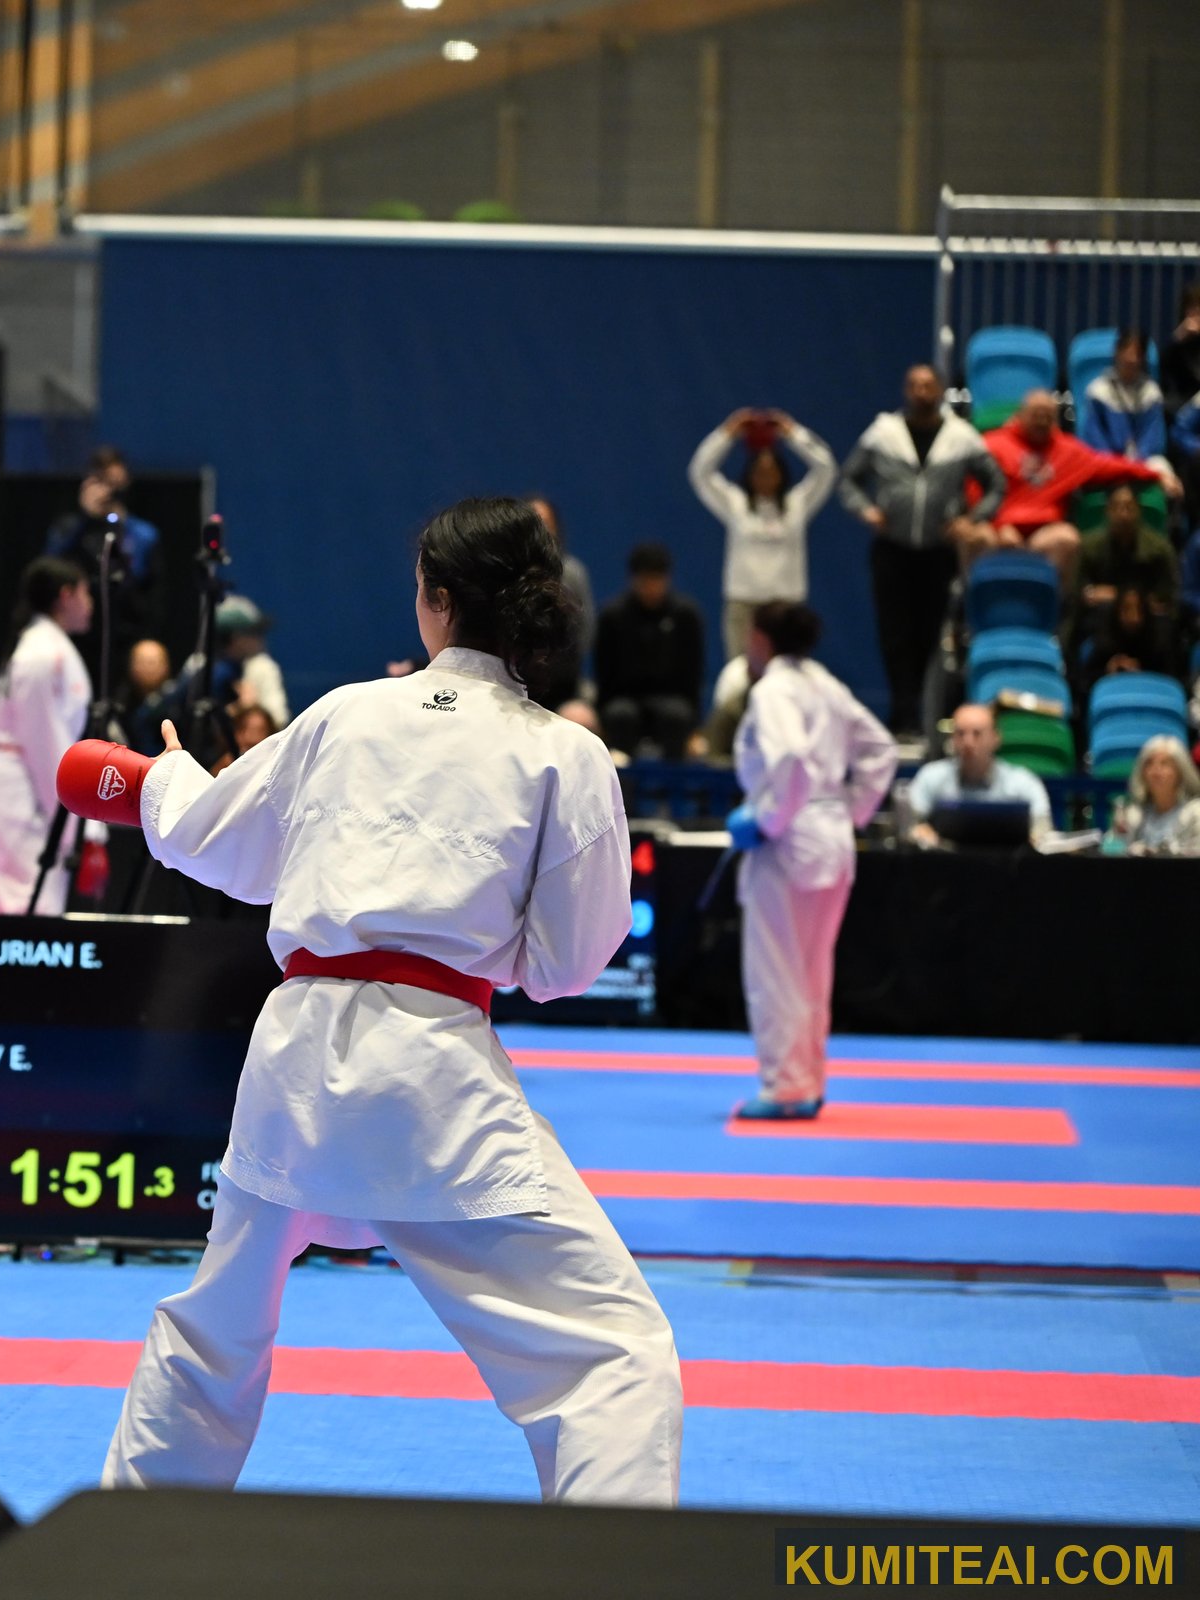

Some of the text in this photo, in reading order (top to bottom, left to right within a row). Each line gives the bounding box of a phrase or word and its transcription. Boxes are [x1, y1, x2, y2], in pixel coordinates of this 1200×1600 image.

[422, 703, 456, 712] TOKAIDO
[101, 768, 114, 798] PUNOK
[79, 942, 103, 969] E.
[9, 1045, 33, 1071] E.
